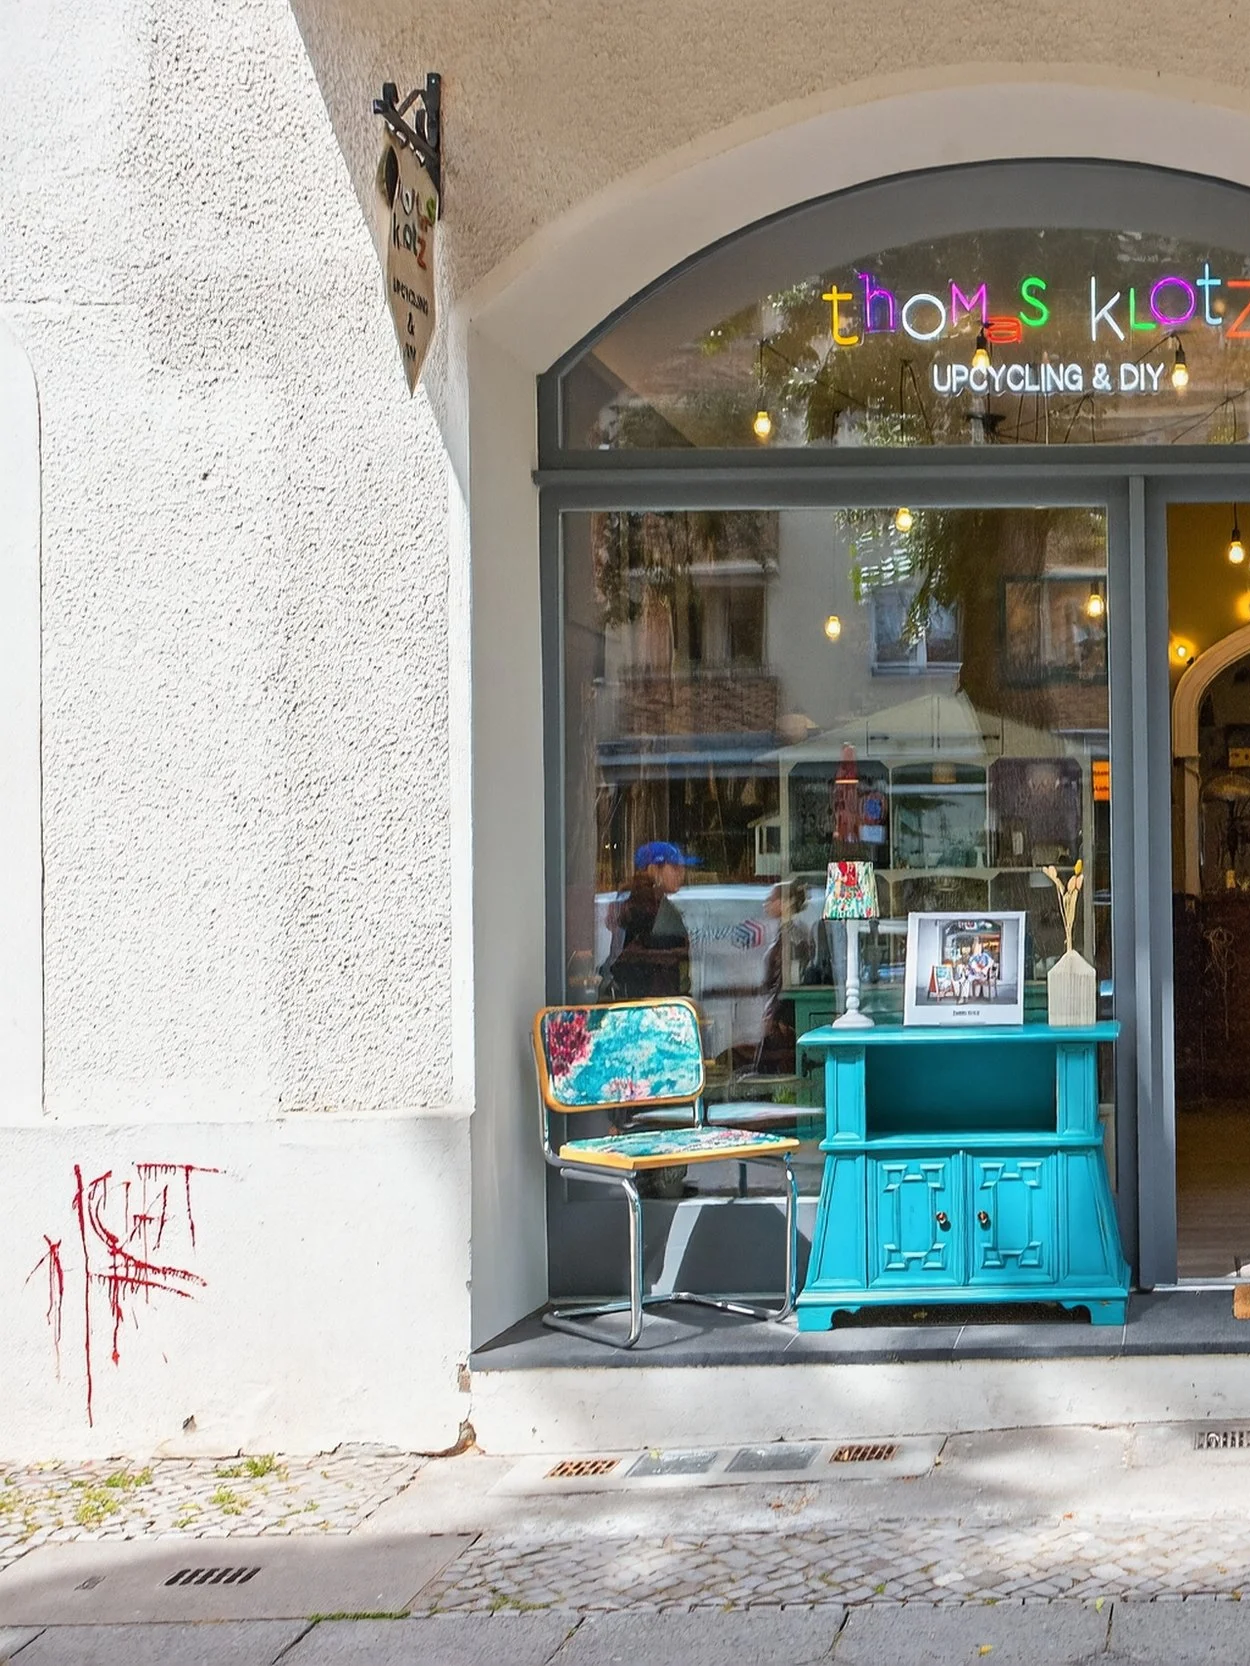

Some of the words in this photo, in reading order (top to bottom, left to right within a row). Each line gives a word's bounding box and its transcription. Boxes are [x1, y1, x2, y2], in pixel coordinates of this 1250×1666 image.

[933, 362, 1083, 392] UPCYCLING
[1092, 362, 1112, 392] &
[1120, 362, 1164, 392] DIY
